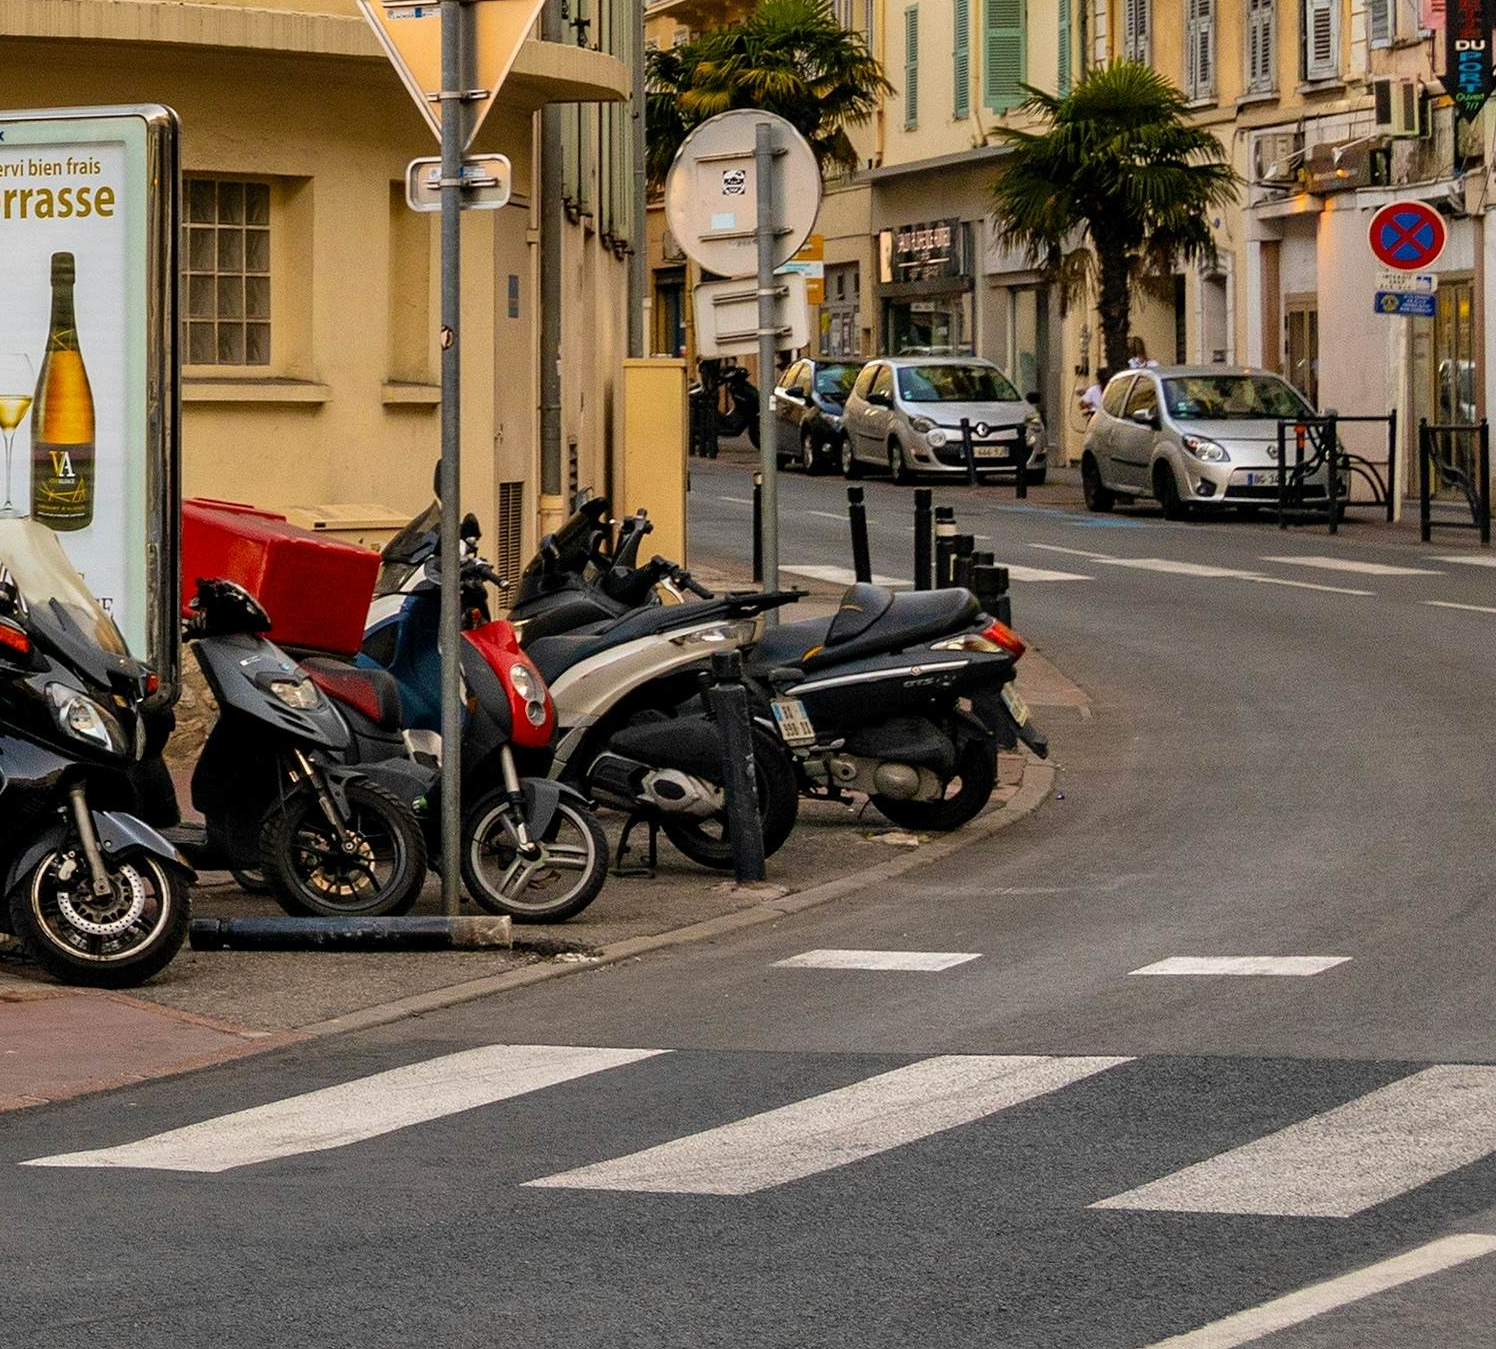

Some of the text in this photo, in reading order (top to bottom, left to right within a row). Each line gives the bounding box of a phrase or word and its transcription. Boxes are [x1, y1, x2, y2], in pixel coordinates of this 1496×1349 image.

[1455, 39, 1486, 51] DU
[1458, 52, 1483, 93] PORT
[28, 158, 62, 176] bien
[66, 157, 101, 175] frais
